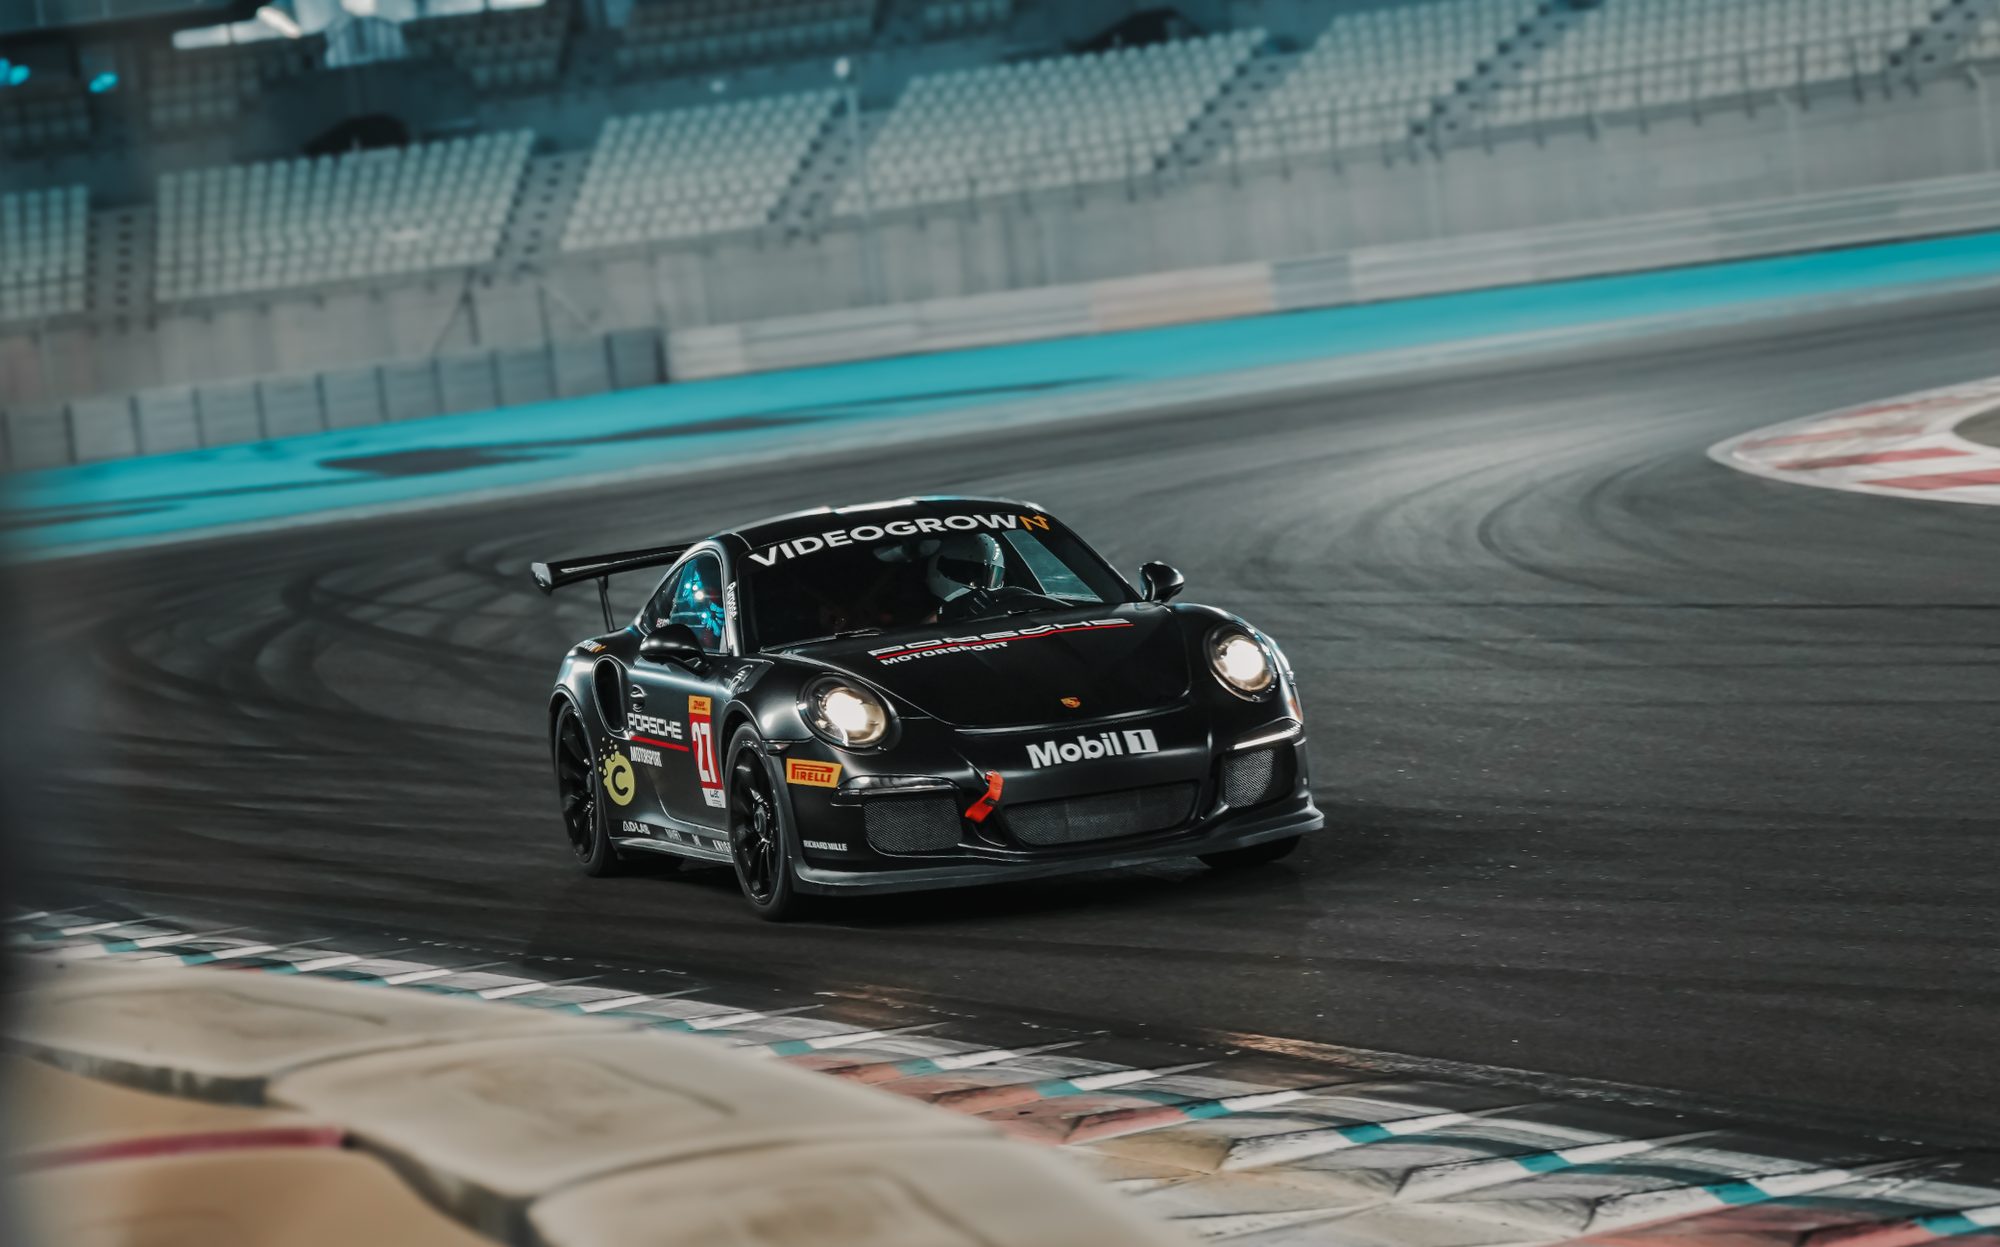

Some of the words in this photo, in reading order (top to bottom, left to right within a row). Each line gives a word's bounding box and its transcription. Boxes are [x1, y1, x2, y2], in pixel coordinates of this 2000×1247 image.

[749, 514, 1050, 567] VIDEOGROWN
[868, 618, 1131, 657] PORSCHE
[880, 641, 1008, 666] MOTORSPORT
[627, 713, 683, 740] PORSCHE
[691, 722, 717, 783] 27
[1025, 732, 1123, 769] Mobil
[791, 763, 834, 783] PIRELLI
[828, 842, 848, 851] MILLE
